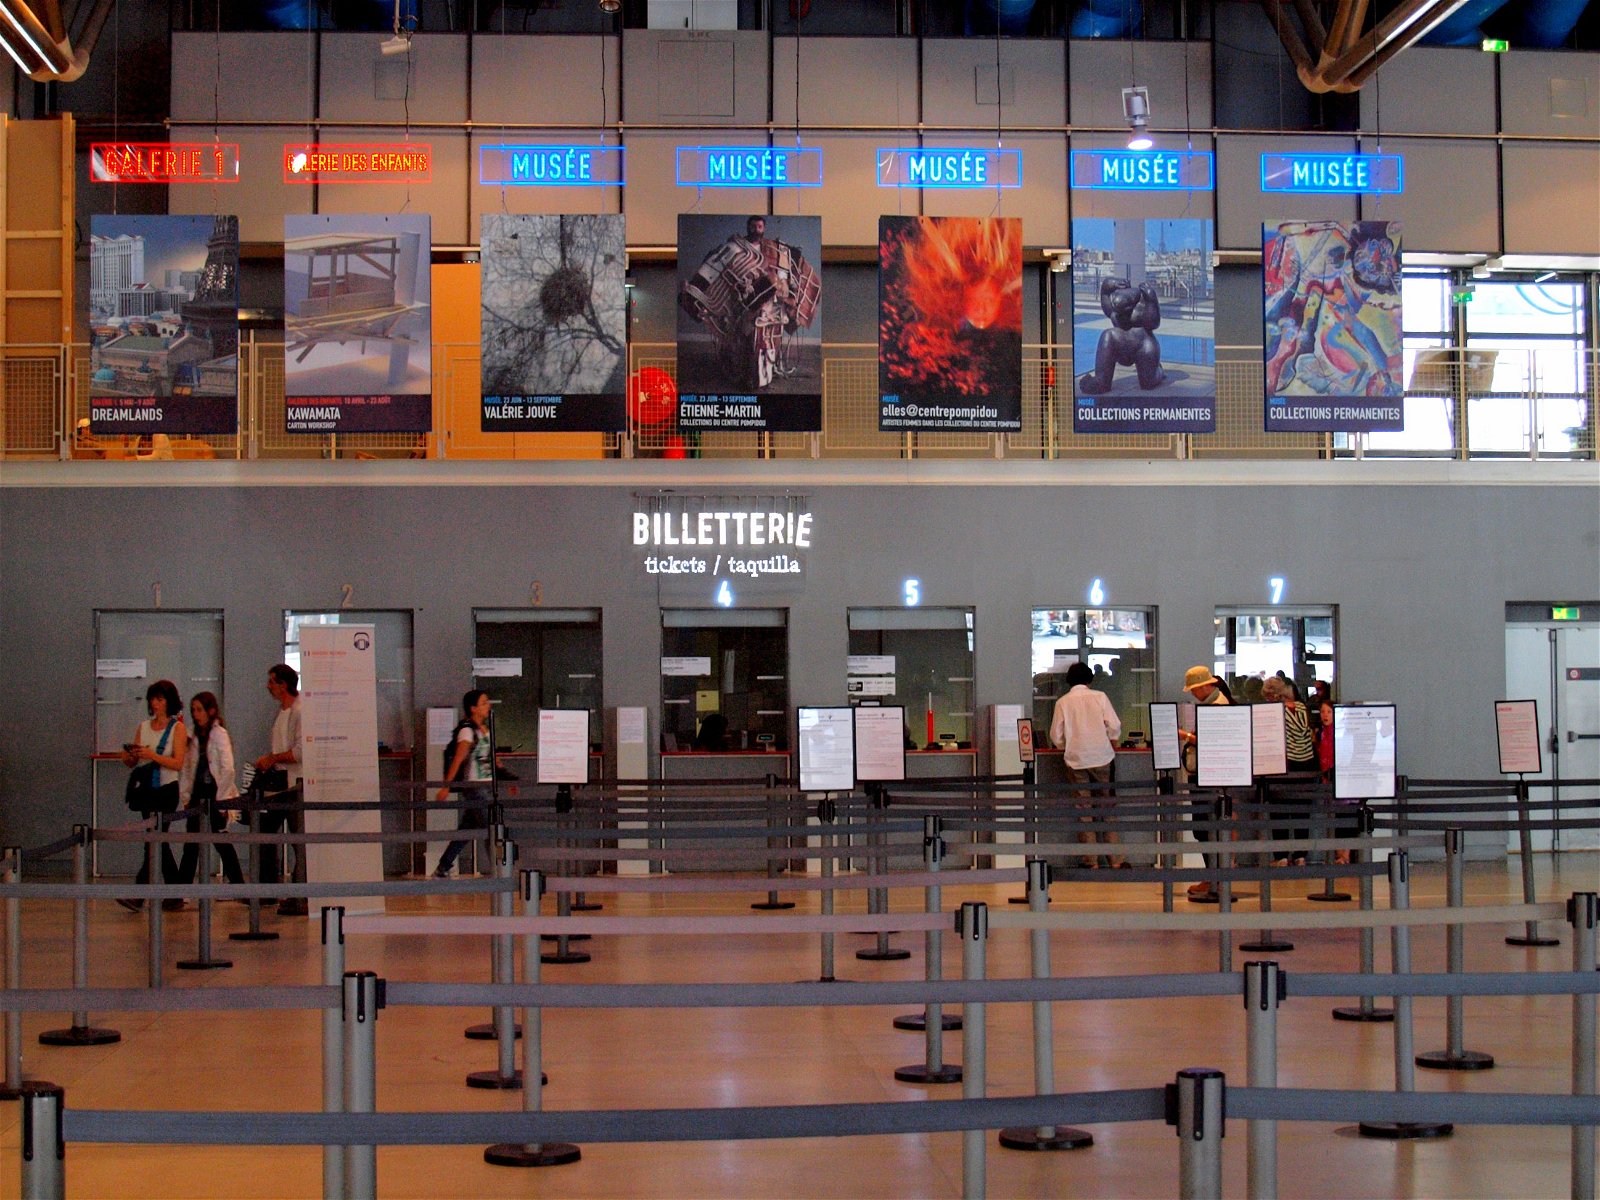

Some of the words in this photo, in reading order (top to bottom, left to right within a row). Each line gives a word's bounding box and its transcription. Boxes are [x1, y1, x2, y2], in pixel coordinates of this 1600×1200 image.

[105, 150, 201, 177] GALERIE
[214, 151, 224, 176] 1
[343, 153, 367, 172] DES
[371, 153, 426, 172] ENFANTS
[513, 148, 591, 180] MUSÉE
[709, 149, 787, 181] MUSÉE
[909, 150, 986, 182] MUSÉE
[1102, 153, 1178, 184] MUSÉE
[1293, 157, 1367, 188] MUSÉE
[510, 396, 522, 404] JUIN
[533, 396, 562, 404] SEPTEMBRE
[882, 394, 899, 403] MUSÉE
[1077, 398, 1095, 406] MUSÉE
[1269, 396, 1286, 405] MUSÉE
[92, 408, 163, 421] DREAMLANDS
[287, 407, 341, 420] KAWAMATA
[484, 403, 523, 419] VALÉRIE
[525, 406, 557, 418] JOUVE
[680, 402, 761, 418] ÉTIENNE-MARTIN
[882, 403, 998, 420] elles@centrepompidou
[1078, 408, 1141, 421] COLLECTIONS
[1143, 408, 1211, 421] PERMANENTES
[1270, 407, 1331, 420] COLLECTIONS
[1333, 407, 1400, 420] PERMANENTES
[287, 421, 307, 430] CARTON
[308, 421, 337, 430] WORKSHOP
[680, 418, 713, 426] COLLECTIONS
[713, 418, 720, 426] DU
[721, 418, 739, 427] CENTRE
[740, 418, 767, 427] POMPIDOU
[902, 419, 922, 427] FEMMES
[922, 419, 934, 427] DANS
[973, 420, 980, 428] DU
[980, 420, 997, 428] CENTRE
[997, 420, 1020, 429] POMPIDOU
[644, 554, 707, 574] tickets
[712, 554, 722, 576] /
[727, 554, 801, 577] taquilla
[151, 582, 161, 607] 1
[341, 583, 353, 608] 2
[531, 580, 542, 607] 3
[718, 580, 732, 607] 4
[905, 579, 919, 606] 5
[1089, 579, 1103, 606] 6
[1270, 578, 1284, 604] 7
